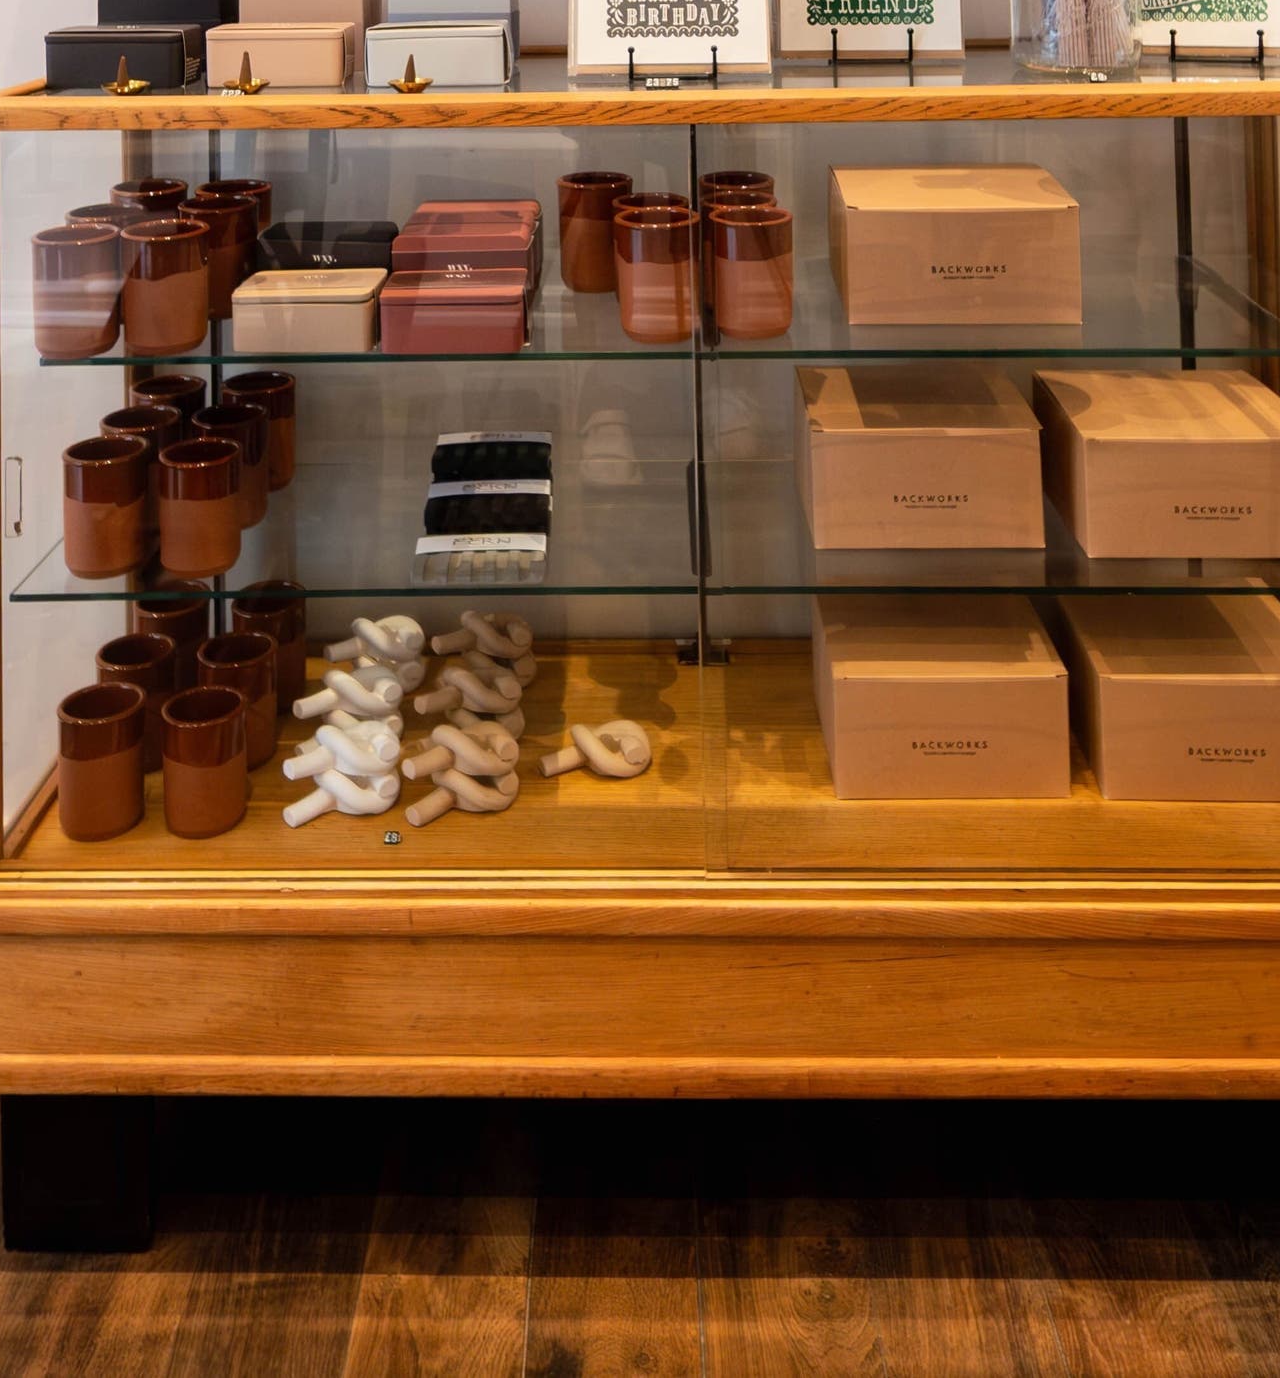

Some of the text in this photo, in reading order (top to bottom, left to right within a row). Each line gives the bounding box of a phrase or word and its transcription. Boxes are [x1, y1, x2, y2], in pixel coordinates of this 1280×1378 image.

[626, 3, 720, 26] BIRTHDAY
[931, 265, 1007, 274] BACKWORKS
[893, 494, 969, 503] BACKWORKS
[1174, 505, 1252, 514] BACKWORKS
[912, 741, 988, 749] BACKWORKS
[1188, 747, 1267, 757] BACKWORKS
